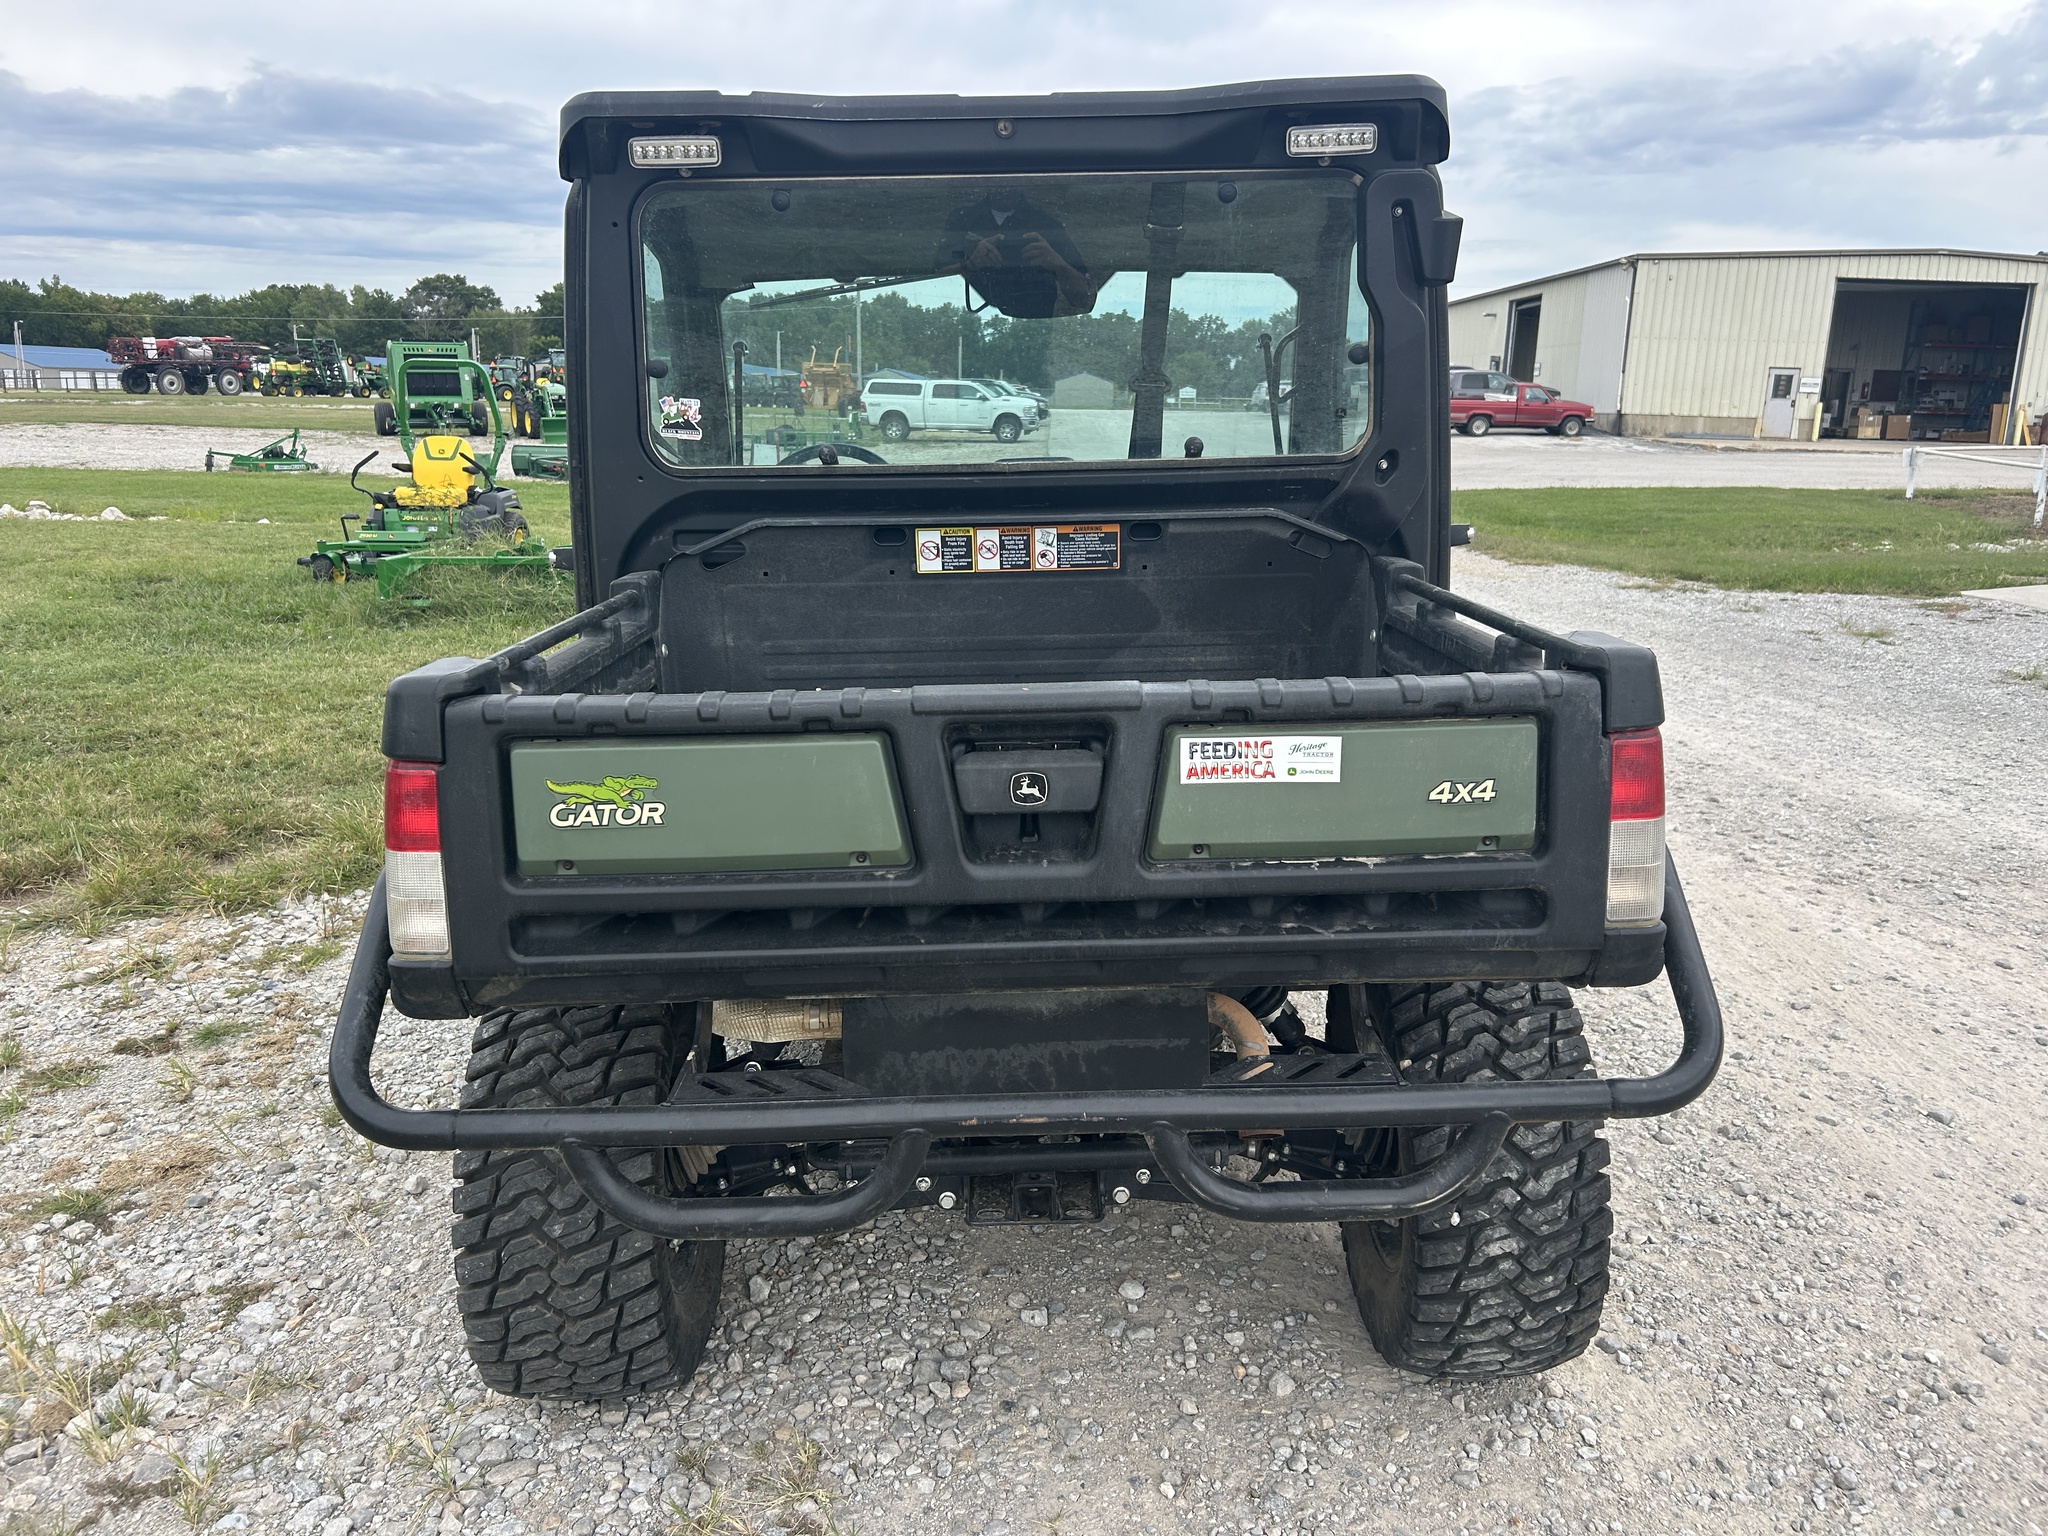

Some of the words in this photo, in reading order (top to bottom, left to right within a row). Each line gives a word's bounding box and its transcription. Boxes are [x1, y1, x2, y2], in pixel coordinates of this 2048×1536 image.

[1188, 740, 1274, 760] FEEDING
[1288, 742, 1328, 756] Heritage
[1186, 761, 1276, 780] AMERICA
[549, 801, 667, 828] GATOR
